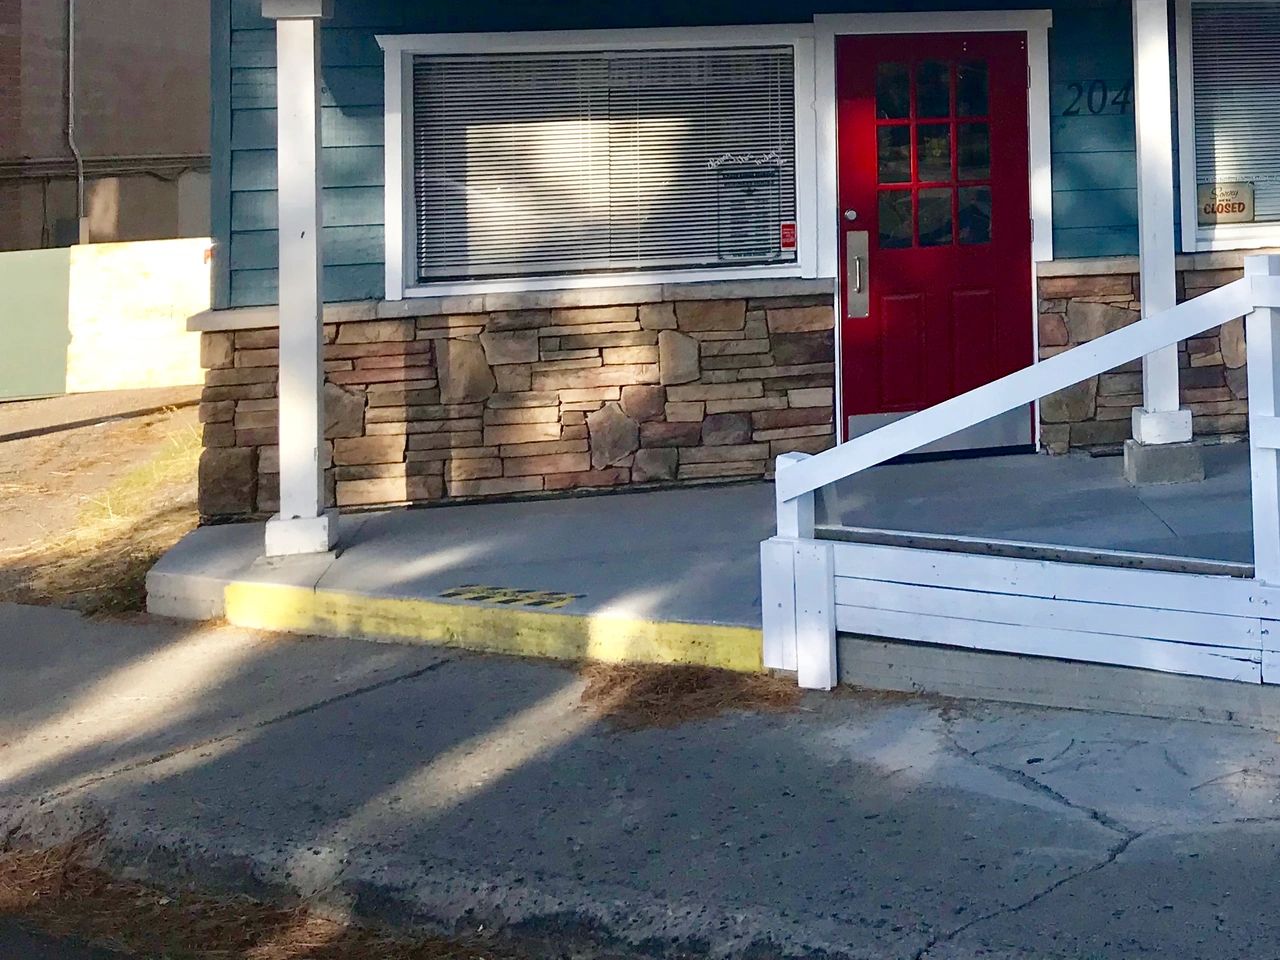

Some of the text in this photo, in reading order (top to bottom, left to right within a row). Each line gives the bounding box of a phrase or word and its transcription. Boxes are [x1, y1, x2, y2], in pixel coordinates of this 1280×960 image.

[1062, 80, 1132, 116] 204
[1209, 186, 1239, 200] Sorry
[1203, 202, 1246, 215] CLOSED
